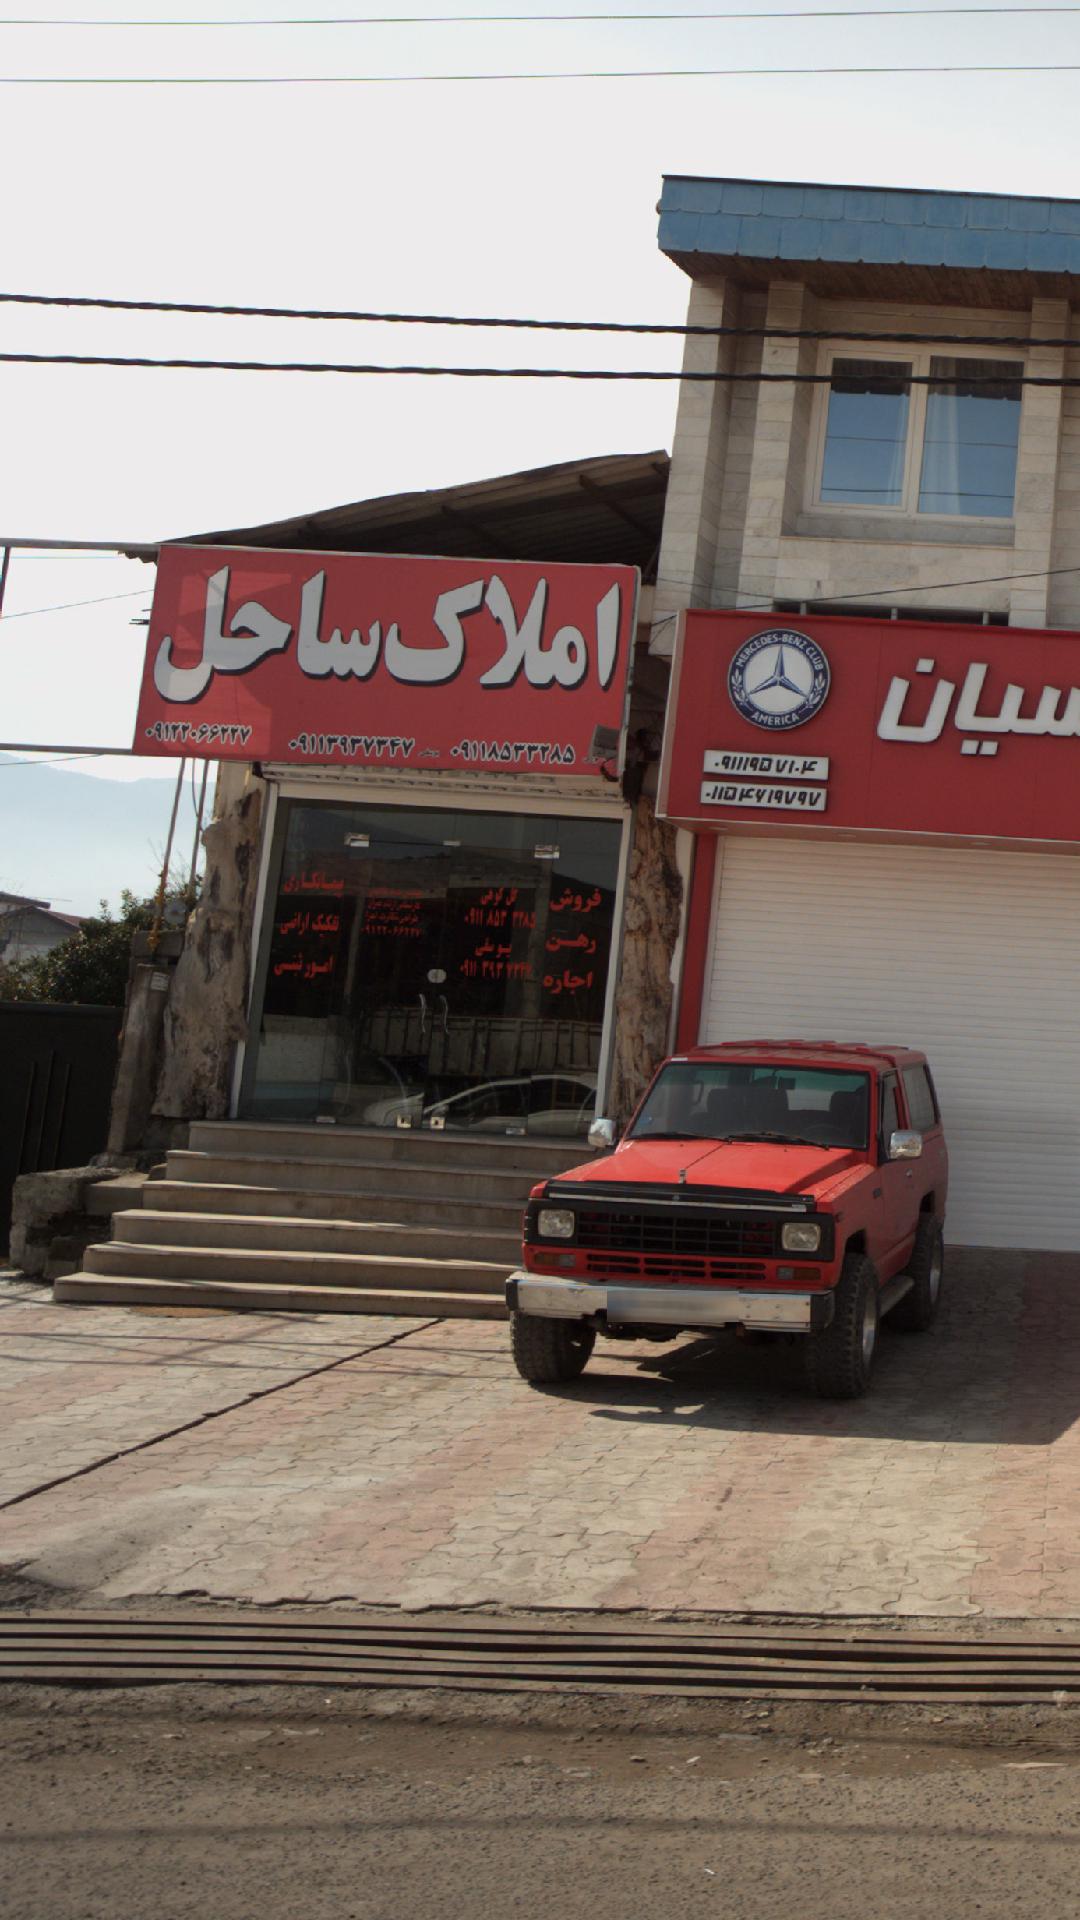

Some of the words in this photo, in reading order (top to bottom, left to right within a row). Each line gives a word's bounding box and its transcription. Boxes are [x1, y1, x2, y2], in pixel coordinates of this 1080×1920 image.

[154, 565, 382, 702] ساحل
[384, 575, 620, 690] املاک
[736, 633, 808, 668] MERCEDES-BENZ
[805, 647, 824, 671] CLUB
[751, 711, 800, 726] AMERICA
[550, 888, 602, 912] فروش
[545, 933, 597, 954] رهن
[543, 969, 594, 995] اجاره
